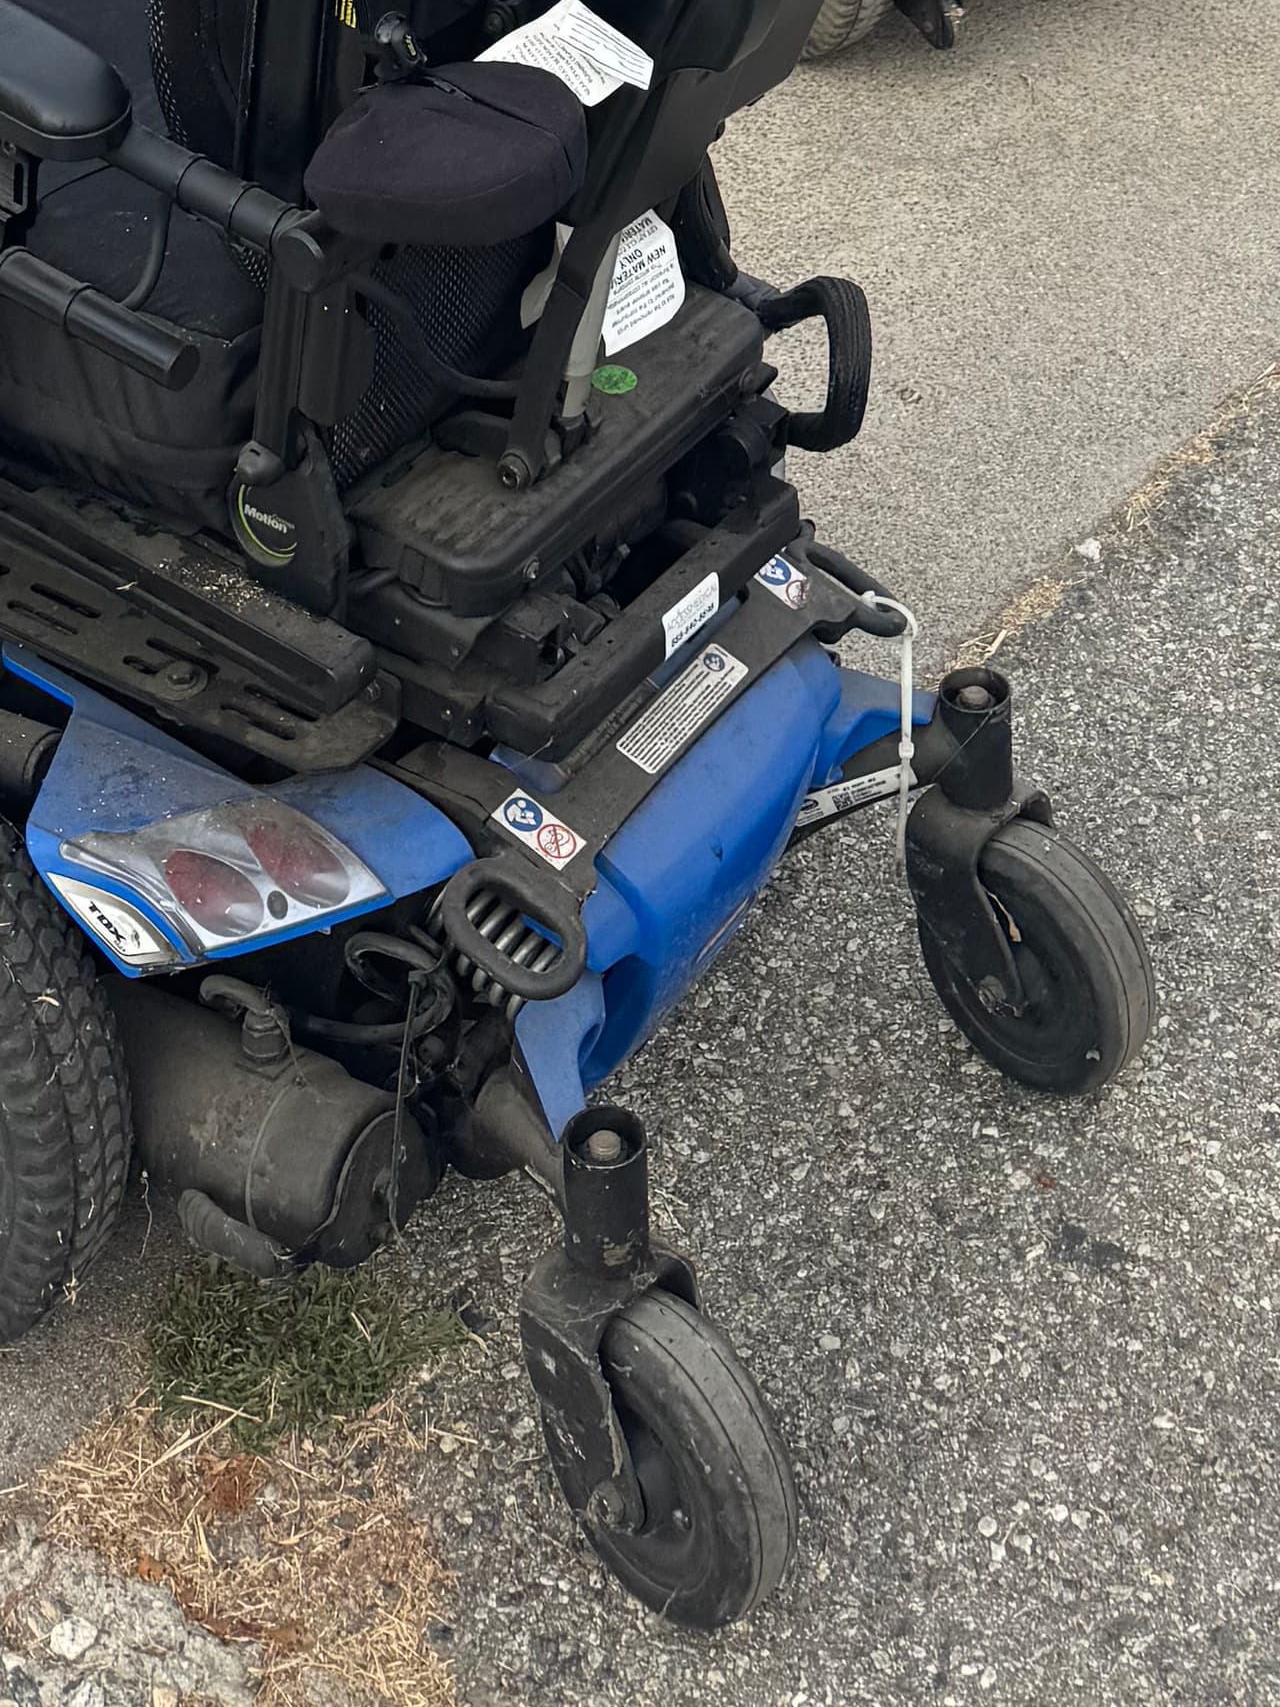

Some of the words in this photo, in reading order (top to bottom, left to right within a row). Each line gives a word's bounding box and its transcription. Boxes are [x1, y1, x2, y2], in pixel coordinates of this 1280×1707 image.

[619, 249, 643, 268] ONLY
[647, 245, 666, 264] NEW
[244, 502, 288, 534] Motion
[88, 900, 127, 943] TDX
